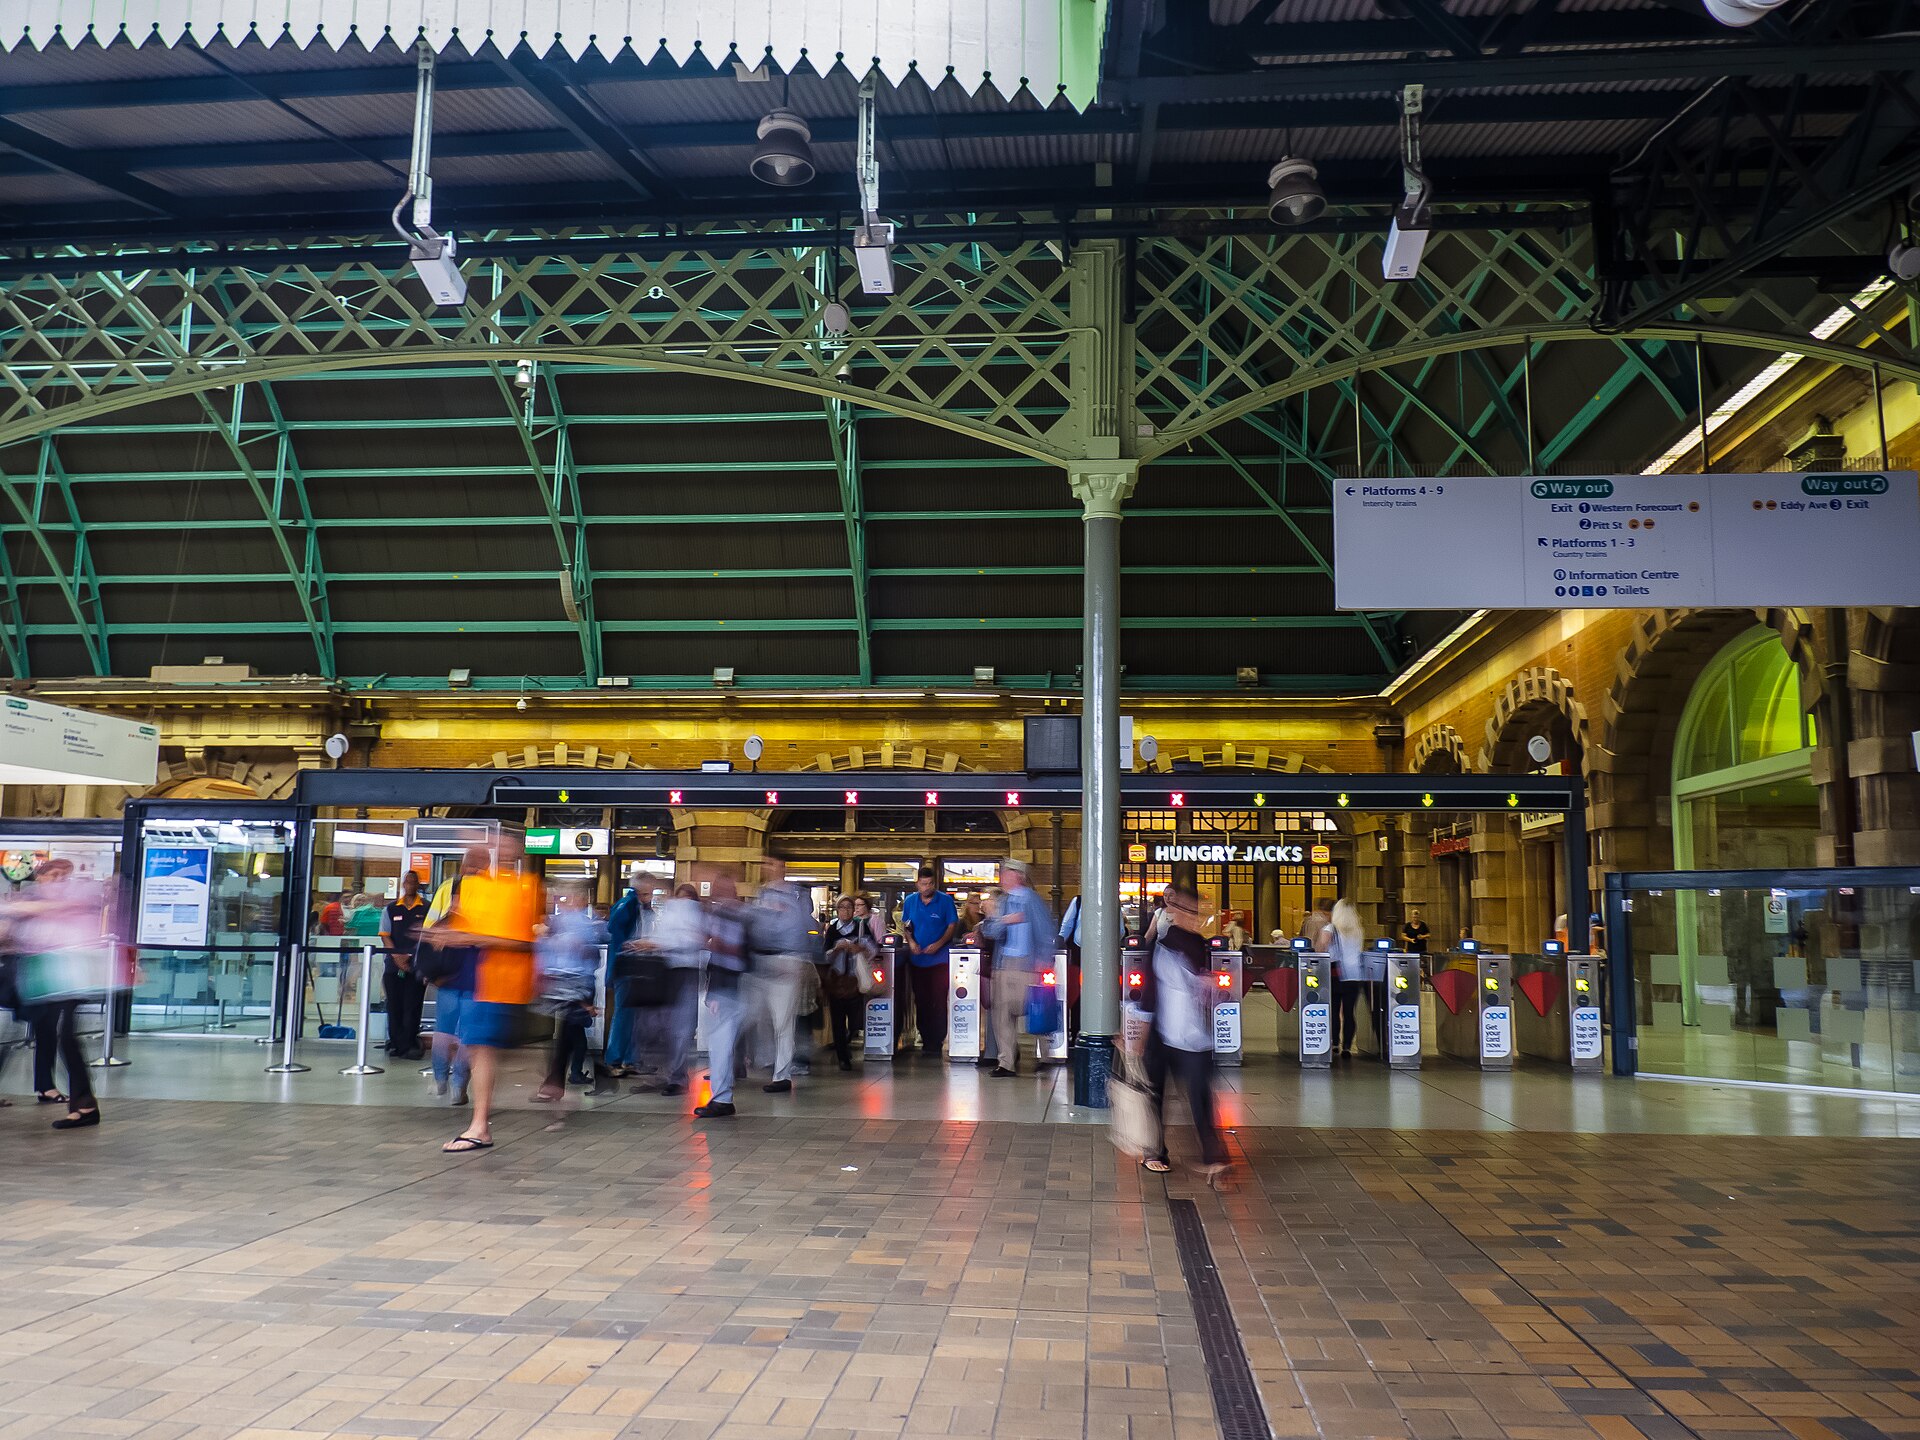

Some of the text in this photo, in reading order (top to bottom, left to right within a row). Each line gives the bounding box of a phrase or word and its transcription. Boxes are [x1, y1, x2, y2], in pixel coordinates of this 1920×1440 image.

[1363, 486, 1416, 495] Platforms
[1419, 486, 1426, 495] 4
[1436, 486, 1443, 495] 9
[1550, 483, 1609, 496] Way out
[1806, 480, 1868, 492] Way out
[1551, 503, 1573, 512] Exit
[1780, 502, 1806, 511] Eddy
[1846, 500, 1869, 509] Exit
[1552, 538, 1607, 548] Platforms
[1611, 539, 1616, 547] 1
[1628, 538, 1635, 547] 3
[1553, 551, 1583, 559] Country
[1569, 570, 1680, 580] Information Centre
[1613, 585, 1650, 595] Toilets
[1155, 845, 1302, 862] HUNGRY JACK'S
[868, 1003, 889, 1012] opal
[1216, 1008, 1237, 1016] opal
[1304, 1009, 1326, 1018] opal
[1394, 1010, 1416, 1019] opal
[1485, 1012, 1506, 1020] opal
[1576, 1013, 1598, 1021] opal
